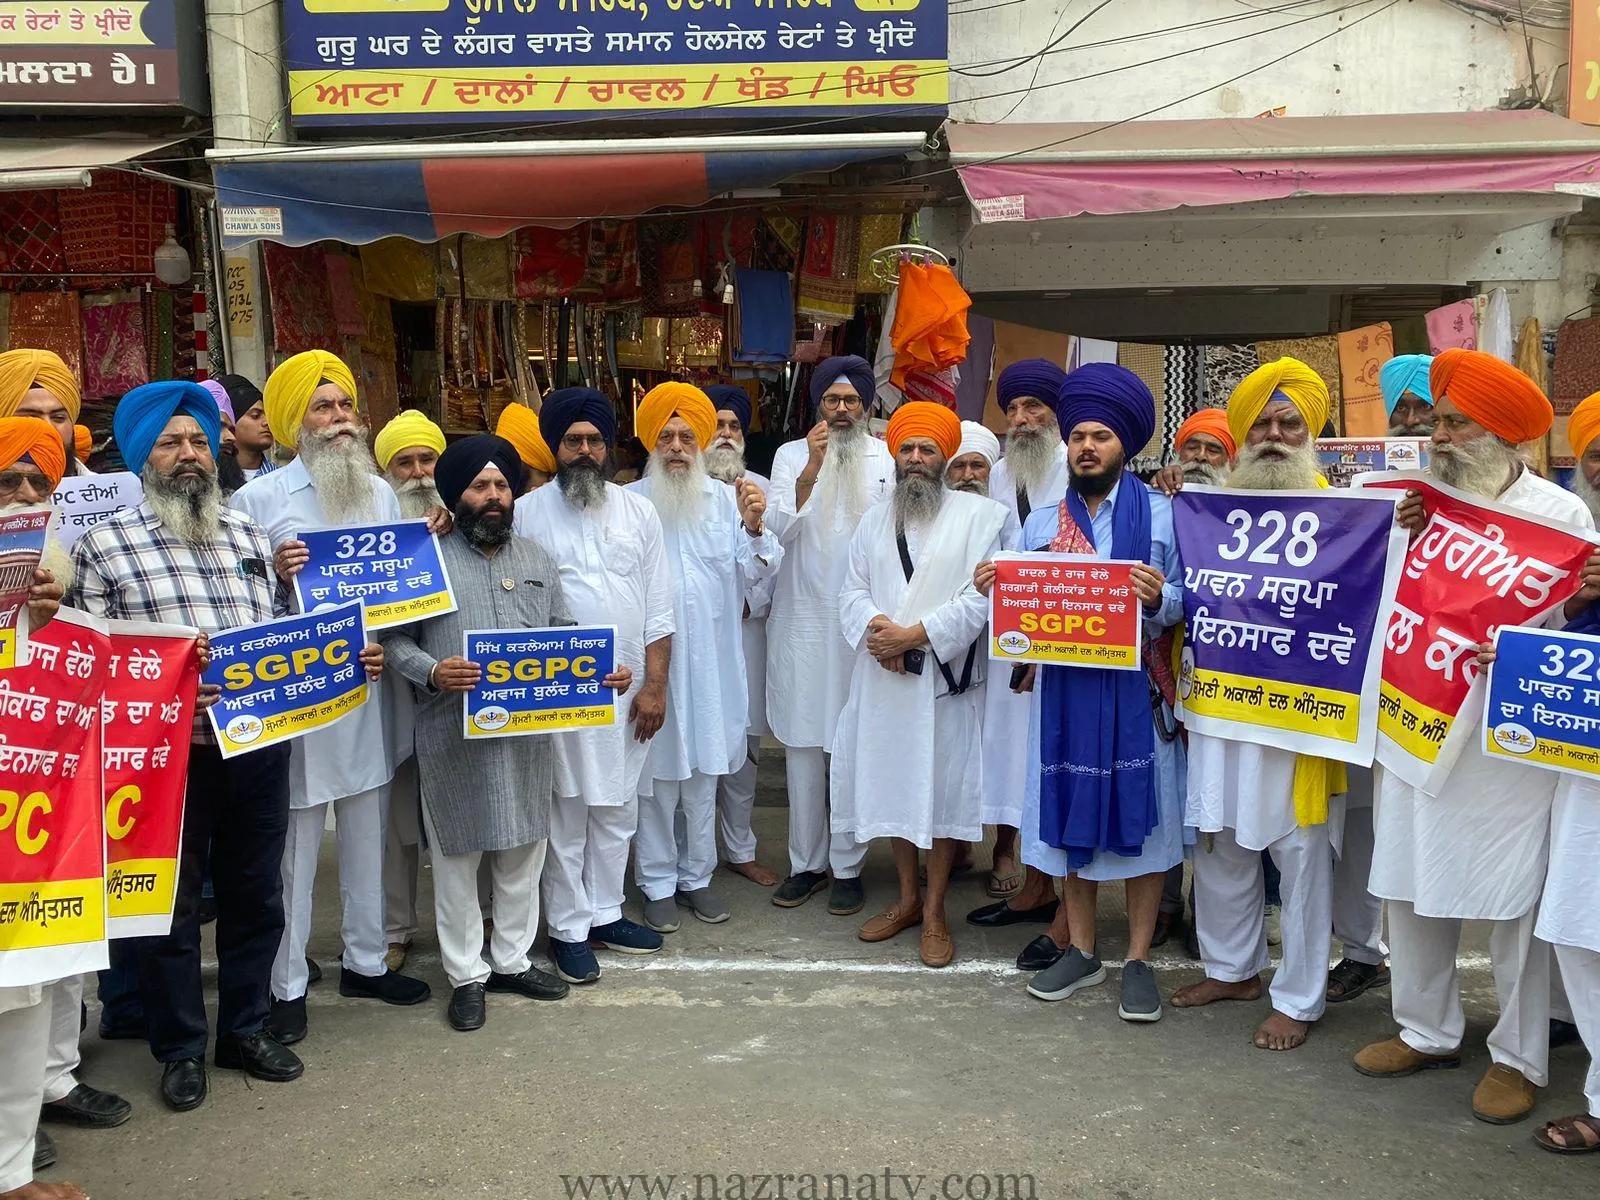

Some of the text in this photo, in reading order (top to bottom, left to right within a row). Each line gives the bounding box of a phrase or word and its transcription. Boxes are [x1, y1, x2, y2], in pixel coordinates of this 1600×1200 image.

[25, 9, 61, 31] ਰੇਟਾਂ
[69, 9, 85, 30] ਤੇ
[94, 8, 132, 37] ਖ੍ਰੀਦੋ
[316, 18, 917, 66] ਗੁਰੂ ਘਰ ਦੇ ਲੰਗਰ ਵਾਸਤੇ ਸਮਾਨ ਹੋਲਸੇਲ ਰੇਟਾਂ ਤੇ ਖ੍ਰੀਦੋ
[315, 82, 404, 106] ਆਟਾ
[453, 73, 537, 104] ਦਾਲਾਂ
[588, 78, 686, 102] ਚਾਵਲ
[735, 66, 793, 101] ਖੰਡ
[843, 64, 920, 99] ਘਿਓ
[1007, 207, 1024, 216] SONS
[225, 222, 281, 230] CHAWLA SONS
[1361, 443, 1381, 452] 1925
[79, 482, 119, 502] ਦੀਆਂ
[335, 531, 397, 559] 328
[1218, 508, 1320, 567] 328
[320, 557, 414, 578] ਪਾਵਨ ਸਰੂਪਾ
[1018, 567, 1109, 580] ਬਾਦਲ ਦੇ ਰਾਜ ਵੇਲੇ
[310, 571, 433, 601] ਦਾ ਇਨਸਾਫ ਦਵੋ
[1000, 582, 1130, 598] ਬਰਗਾੜੀ ਗੋਲੀਕਾਂਡ ਦਾ ਅਤੇ
[1184, 567, 1338, 618] ਪਾਵਨ ਸਰੂਪਾ
[394, 605, 407, 614] ਦਲ
[1002, 596, 1126, 613] ਬੇਅਦਬੀ ਦਾ ਇਨਸਾਫ ਦਵੇ
[241, 628, 310, 652] ਕਤਲੇਆਮ
[316, 616, 356, 637] ਖਿਲਾਫ
[1019, 612, 1107, 637] SGPC
[1192, 606, 1356, 665] ਇਨਸਾਫ ਦਵੋ
[475, 636, 607, 655] ਸਿੱਖ ਕਤਲੇਆਮ ਖਿਲਾਫ
[1054, 645, 1077, 656] ਅਕਾਲੀ
[1080, 648, 1092, 657] ਦਲ
[65, 641, 96, 679] ਵੇਲੇ
[128, 648, 162, 680] ਵੇਲੇ
[224, 639, 350, 690] SGPC
[486, 655, 597, 684] SGPC
[1539, 644, 1600, 682] 32
[224, 663, 355, 711] ਅਵਾਜ ਬੁਲੰਦ ਕਰੇ
[482, 679, 600, 701] ਅਵਾਜ ਬੁਲੰਦ ਕਰੇ
[1223, 682, 1264, 707] ਅਕਾਲੀ
[1268, 692, 1290, 711] ਦਲ
[1518, 677, 1574, 701] ਪਾਵਨ
[0, 679, 50, 722] ੀਕਾਂਡ
[56, 700, 76, 726] ਦਾ
[127, 701, 153, 724] ਦਾ
[160, 694, 183, 725] ਅਤੇ
[290, 708, 317, 724] ਅਕਾਲੀ
[320, 705, 333, 717] ਦਲ
[534, 712, 558, 725] ਅਕਾਲੀ
[560, 711, 573, 722] ਦਲ
[1402, 709, 1419, 731] ਦਲ
[1500, 701, 1600, 733] ਦਾ ਇਨਸਾ
[151, 738, 171, 769] ਦਵੇ
[1567, 748, 1599, 765] ਅਕਾਲੀ
